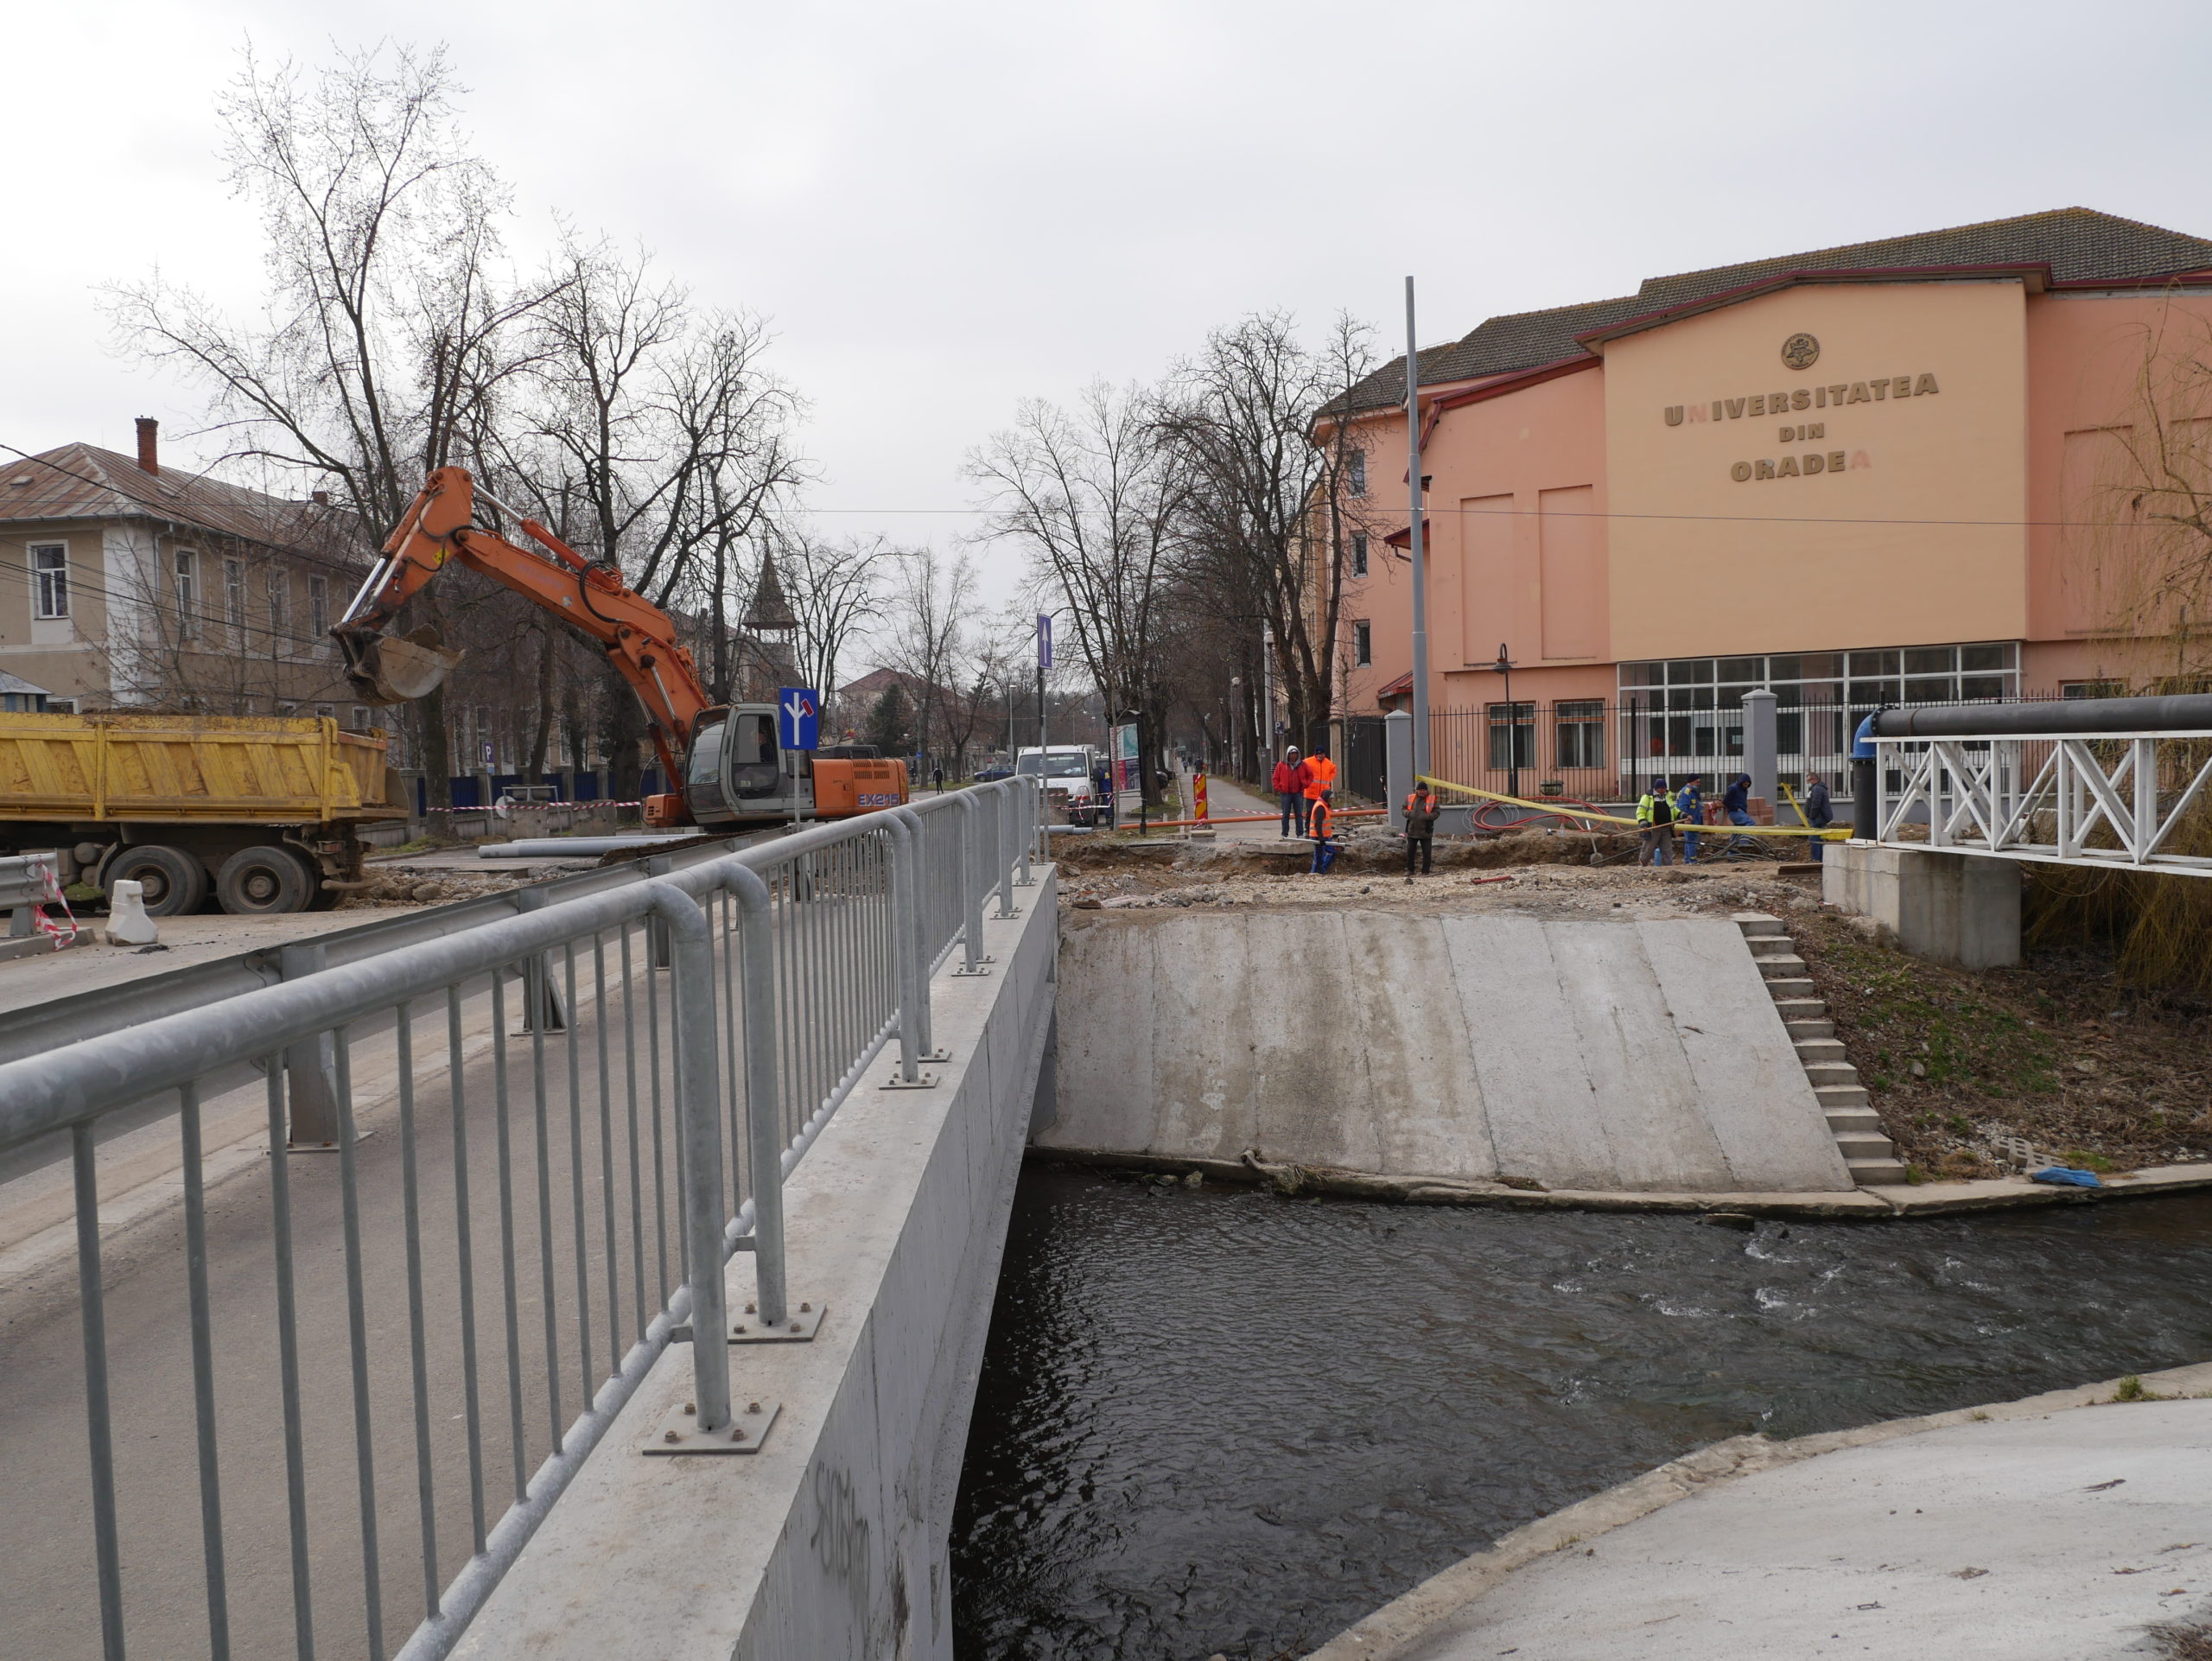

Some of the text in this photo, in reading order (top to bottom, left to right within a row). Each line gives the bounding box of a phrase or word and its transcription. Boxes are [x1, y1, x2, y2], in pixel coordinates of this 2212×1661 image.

[1664, 372, 1940, 427] UNIVERSITATEA
[1779, 423, 1825, 442] DIN
[1731, 449, 1872, 482] ORADEA
[485, 745, 492, 760] P
[858, 793, 899, 806] EX215
